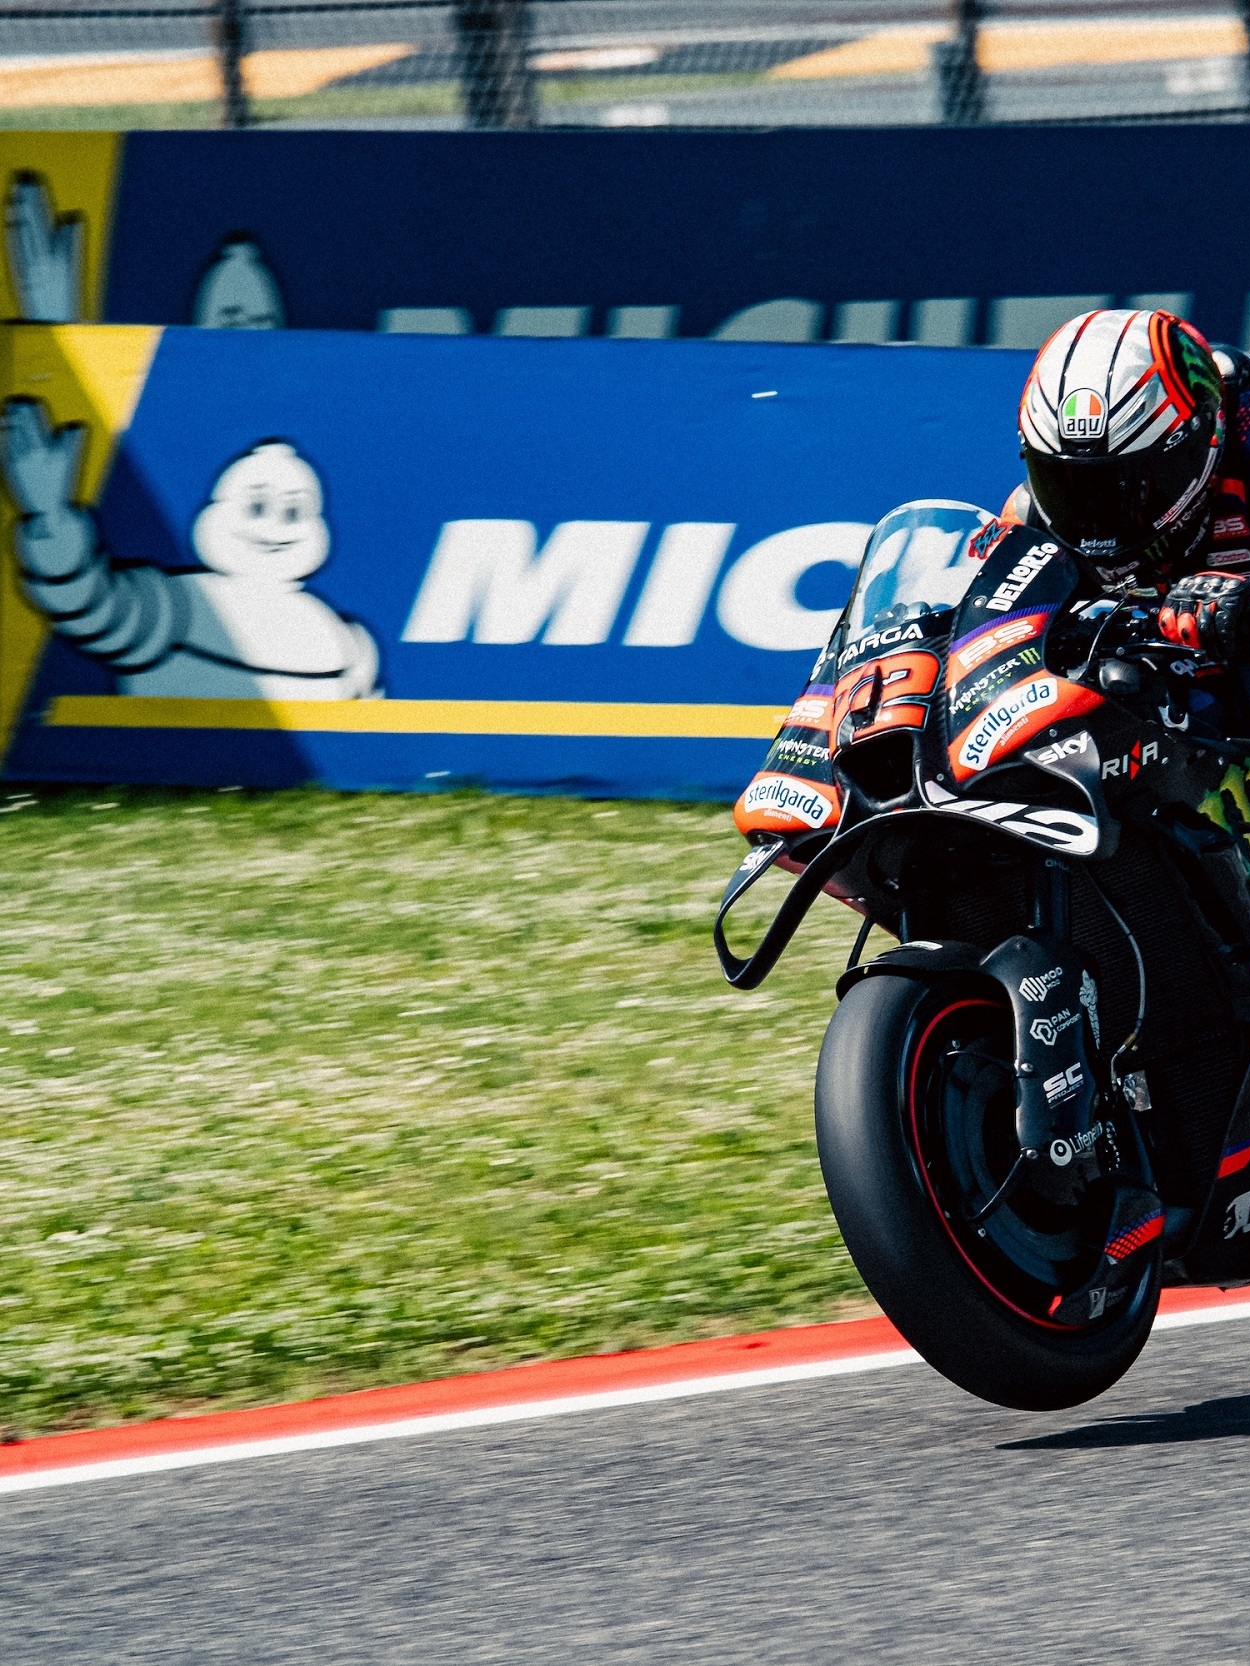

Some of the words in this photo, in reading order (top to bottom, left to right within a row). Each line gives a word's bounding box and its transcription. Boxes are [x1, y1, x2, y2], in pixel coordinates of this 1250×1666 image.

[1066, 417, 1100, 436] agv
[838, 623, 924, 670] TARGA
[957, 619, 1034, 666] BS
[948, 658, 1022, 715] MONSTER
[966, 683, 1051, 765] sterilgarda
[778, 739, 831, 761] MONSTER
[778, 753, 819, 767] ENERGY
[1037, 732, 1089, 766] sky
[749, 780, 825, 821] sterilgarda
[763, 808, 793, 822] alimenti
[1051, 1008, 1071, 1025] PAN
[1043, 1062, 1083, 1098] SC
[1048, 1079, 1084, 1104] PROJECT
